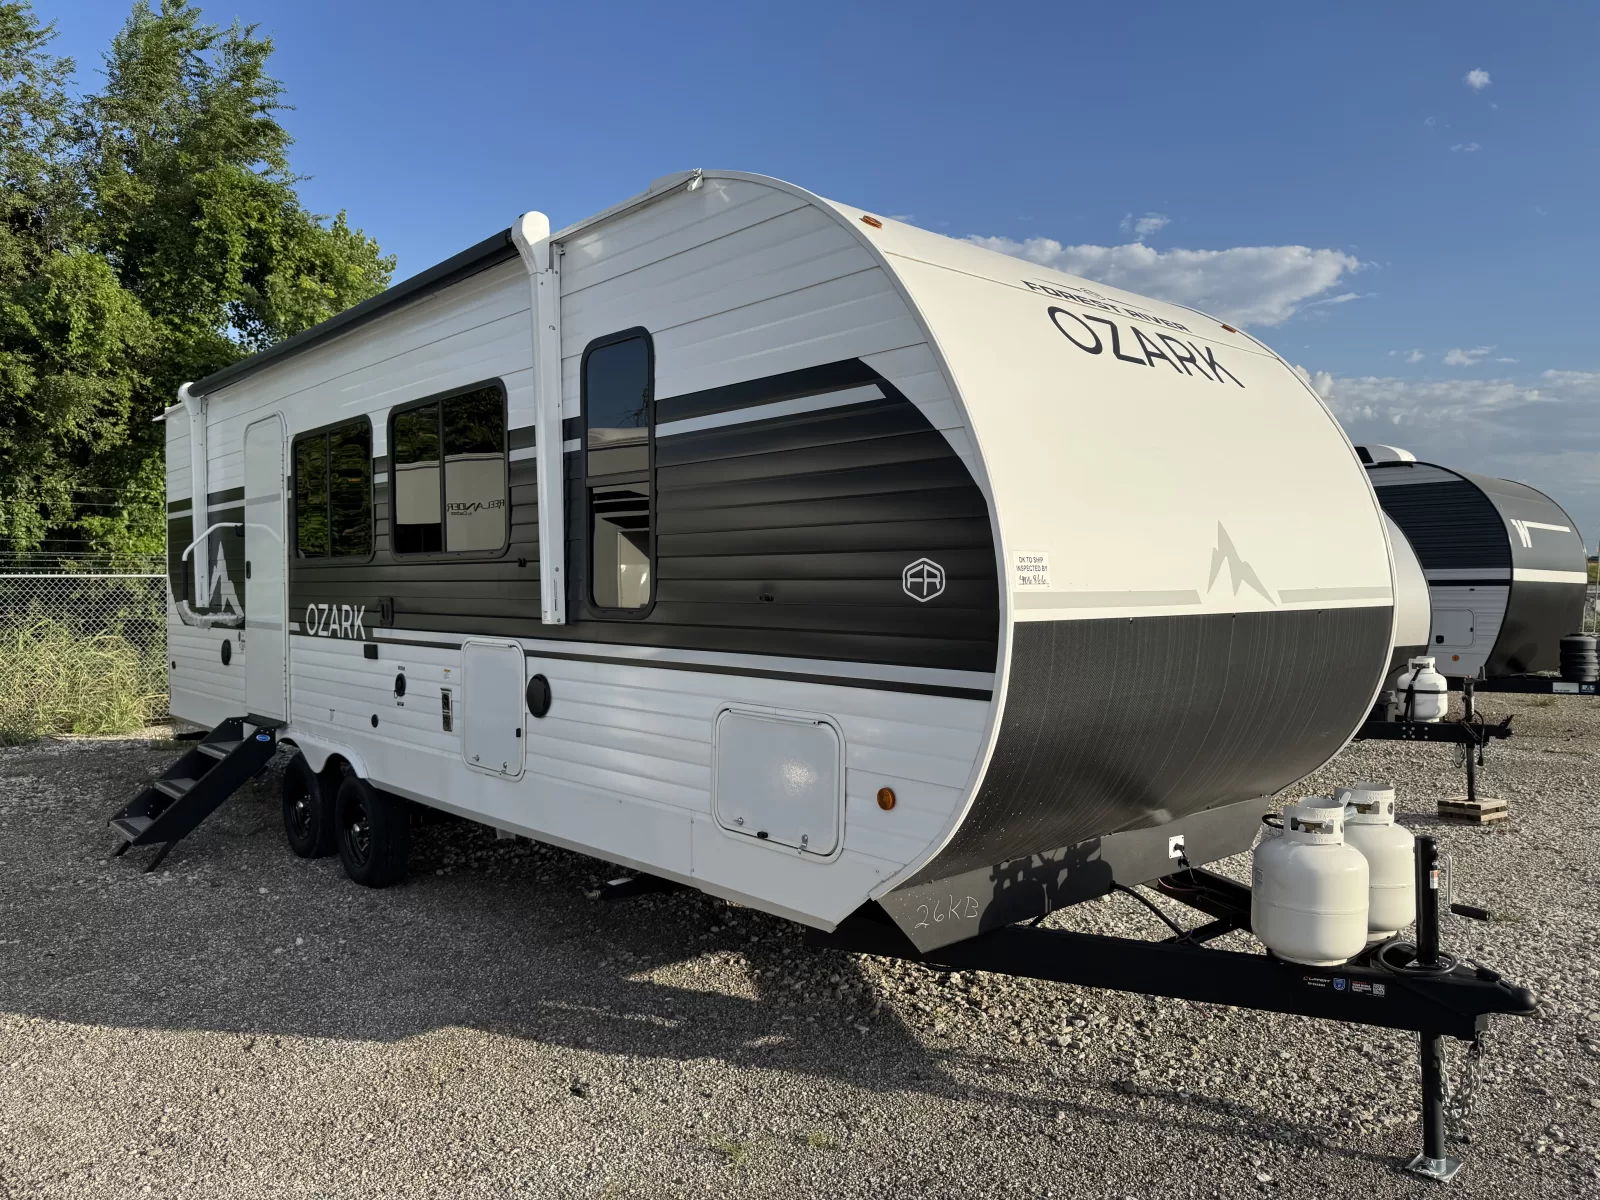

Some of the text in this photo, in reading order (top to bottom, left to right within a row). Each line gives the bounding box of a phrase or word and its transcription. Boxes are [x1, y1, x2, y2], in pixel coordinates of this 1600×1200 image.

[1020, 279, 1121, 313] FOREST
[1123, 308, 1193, 333] RIVER
[1047, 305, 1246, 388] OZARK
[1033, 556, 1044, 564] SHIP
[305, 603, 367, 640] OZARK
[914, 894, 979, 929] 26KB
